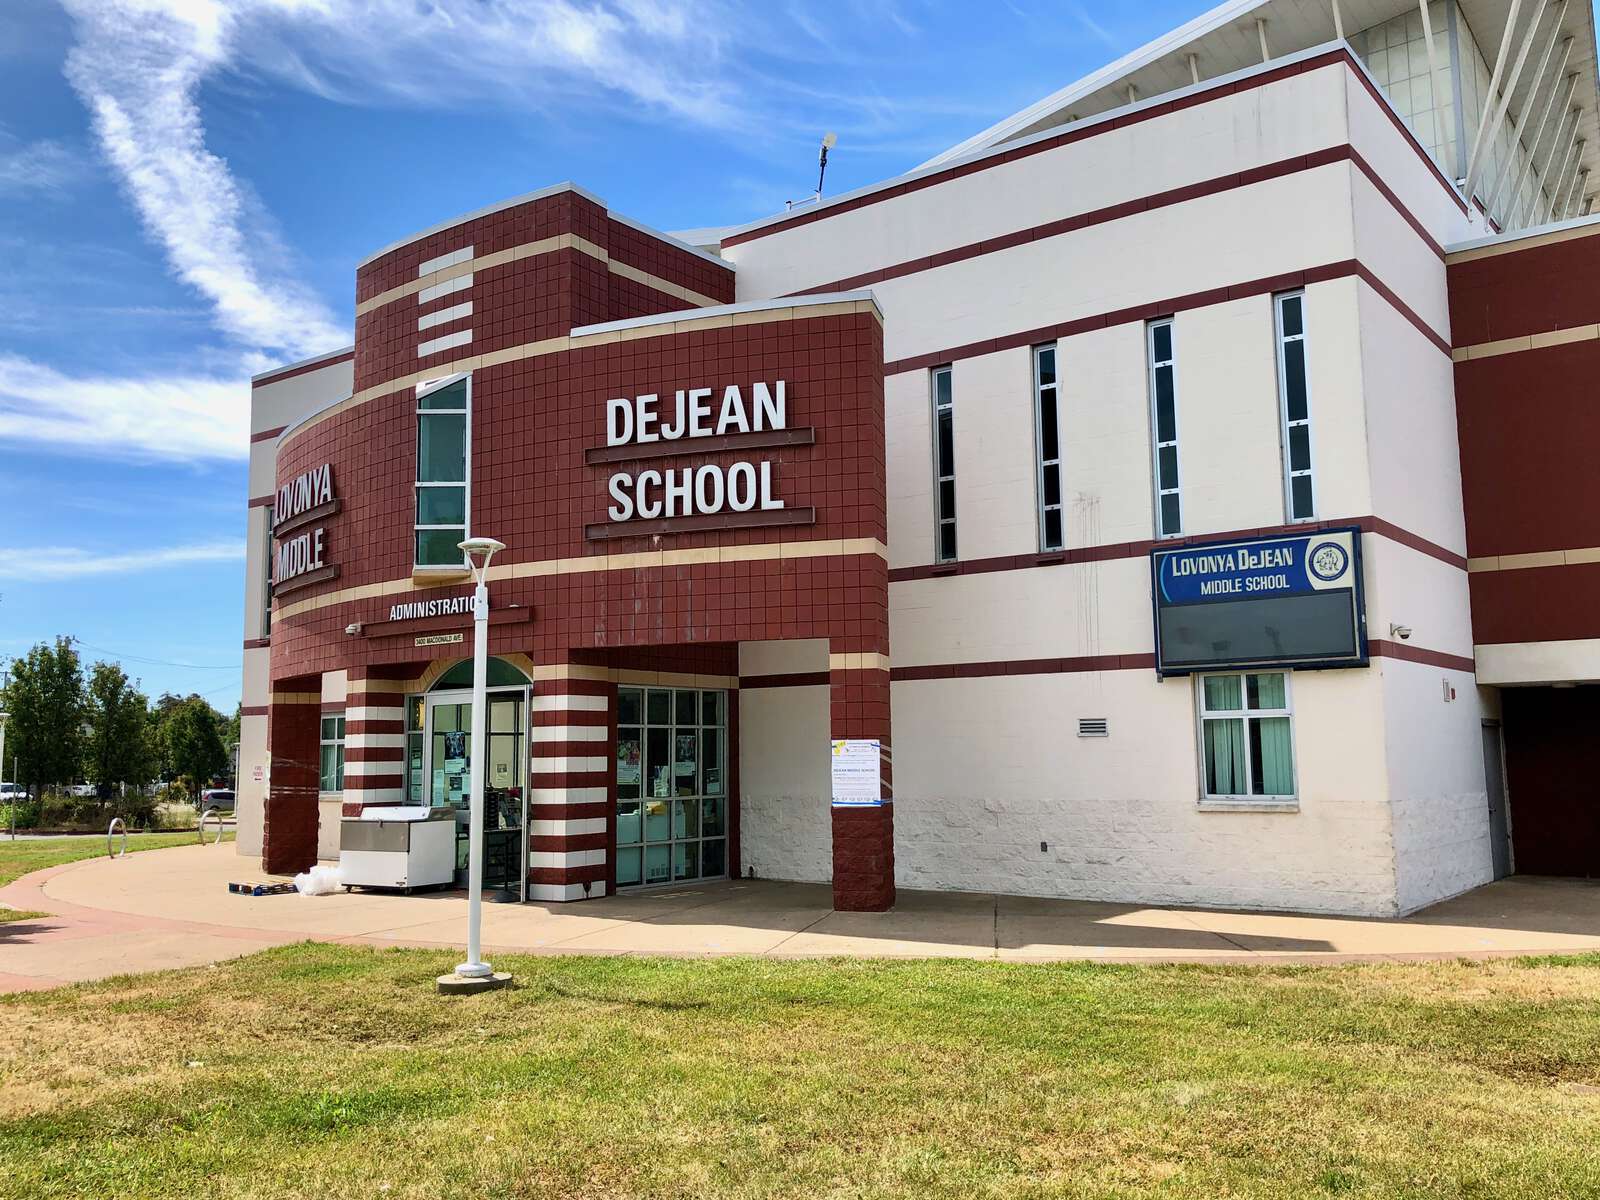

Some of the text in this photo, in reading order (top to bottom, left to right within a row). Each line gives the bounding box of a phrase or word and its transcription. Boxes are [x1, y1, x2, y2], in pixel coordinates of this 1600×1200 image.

[606, 380, 786, 446] DEJEAN
[274, 463, 332, 524] LOVONYA
[608, 460, 785, 522] SCHOOL
[276, 528, 324, 583] MIDDLE
[1172, 547, 1293, 577] LOVONYA DeJEAN
[389, 596, 475, 620] ADMINISTRATIO
[1201, 573, 1290, 595] MIDDLE SCHOOL
